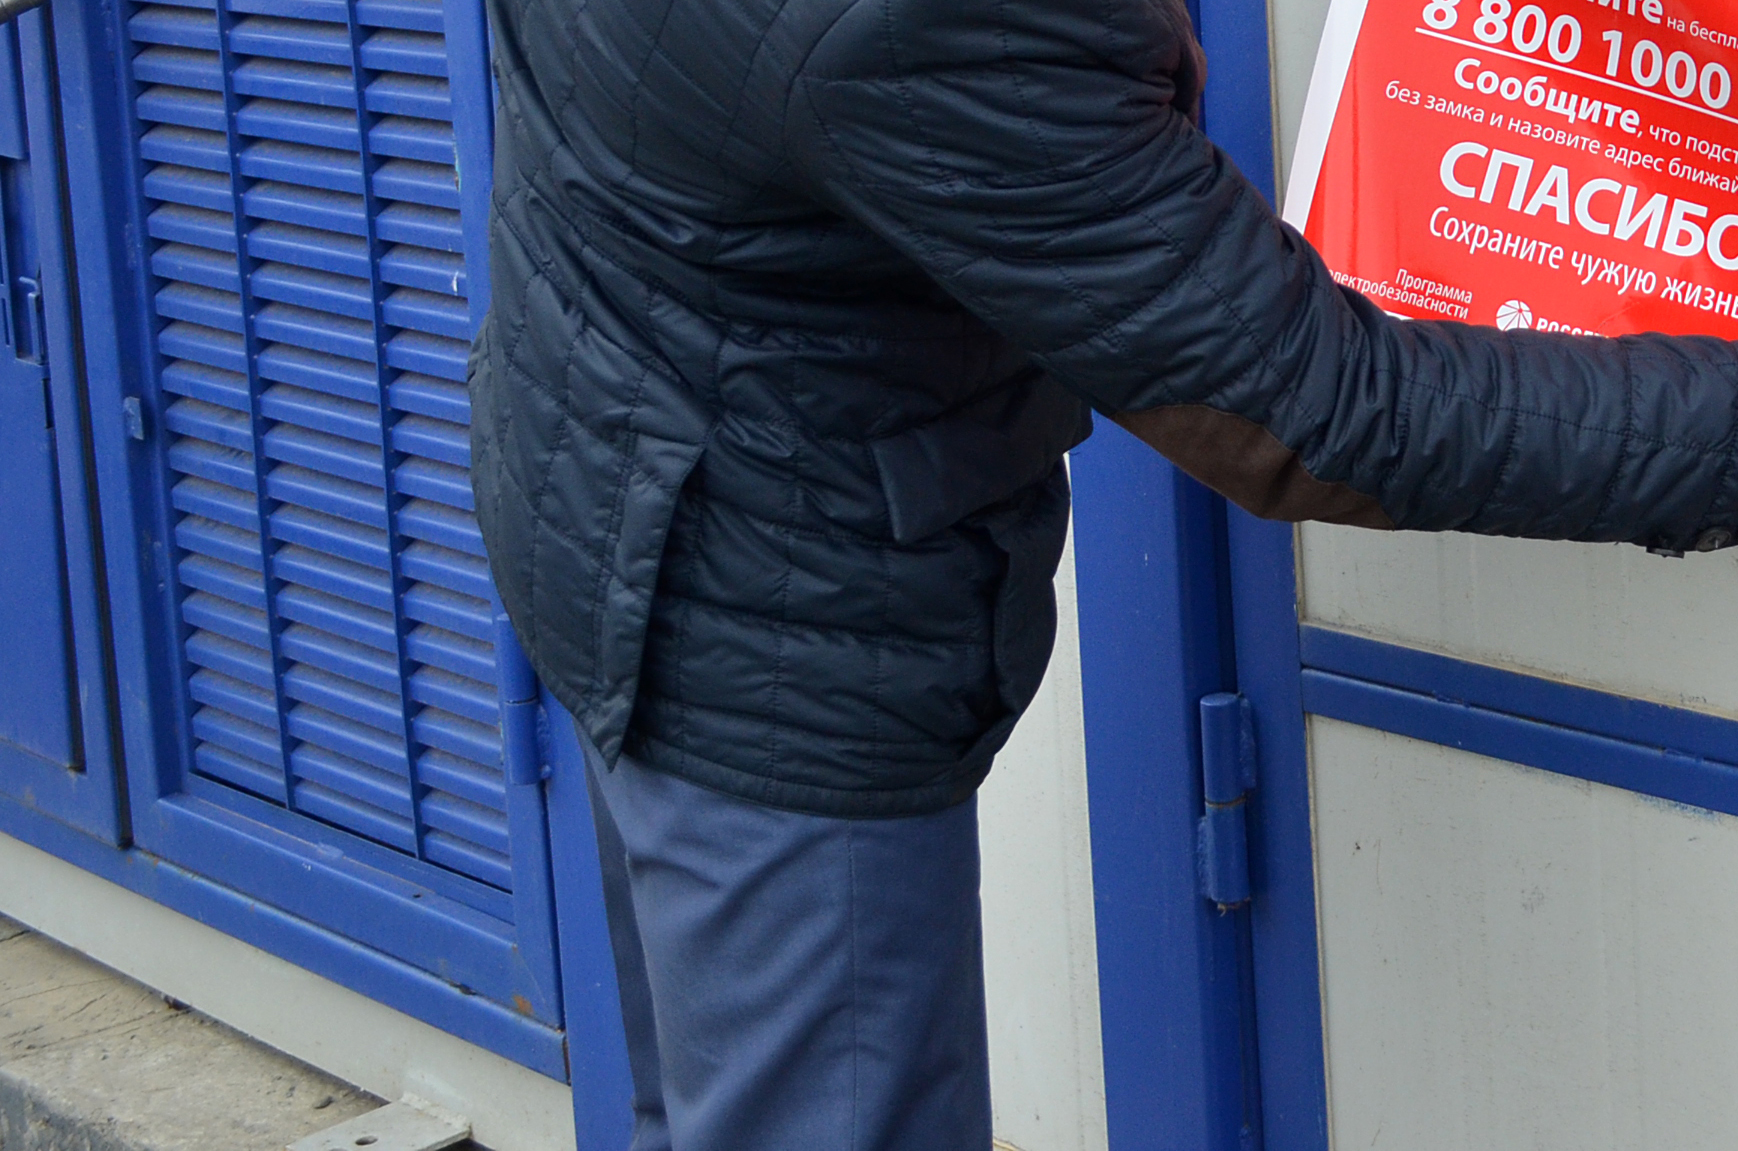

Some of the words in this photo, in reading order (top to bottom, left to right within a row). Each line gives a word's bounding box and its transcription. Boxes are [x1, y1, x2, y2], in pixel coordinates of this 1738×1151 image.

[1667, 17, 1686, 32] на
[1454, 58, 1643, 138] Сообщите,
[1649, 124, 1681, 146] что
[1602, 29, 1731, 109] 1000
[1385, 80, 1421, 105] без
[1424, 94, 1485, 123] замка
[1489, 113, 1503, 128] и
[1507, 117, 1600, 154] назовите
[1604, 144, 1665, 172] адрес
[1395, 268, 1473, 304] Программа
[1429, 206, 1564, 269] Сохраните
[1571, 251, 1656, 295] чужую
